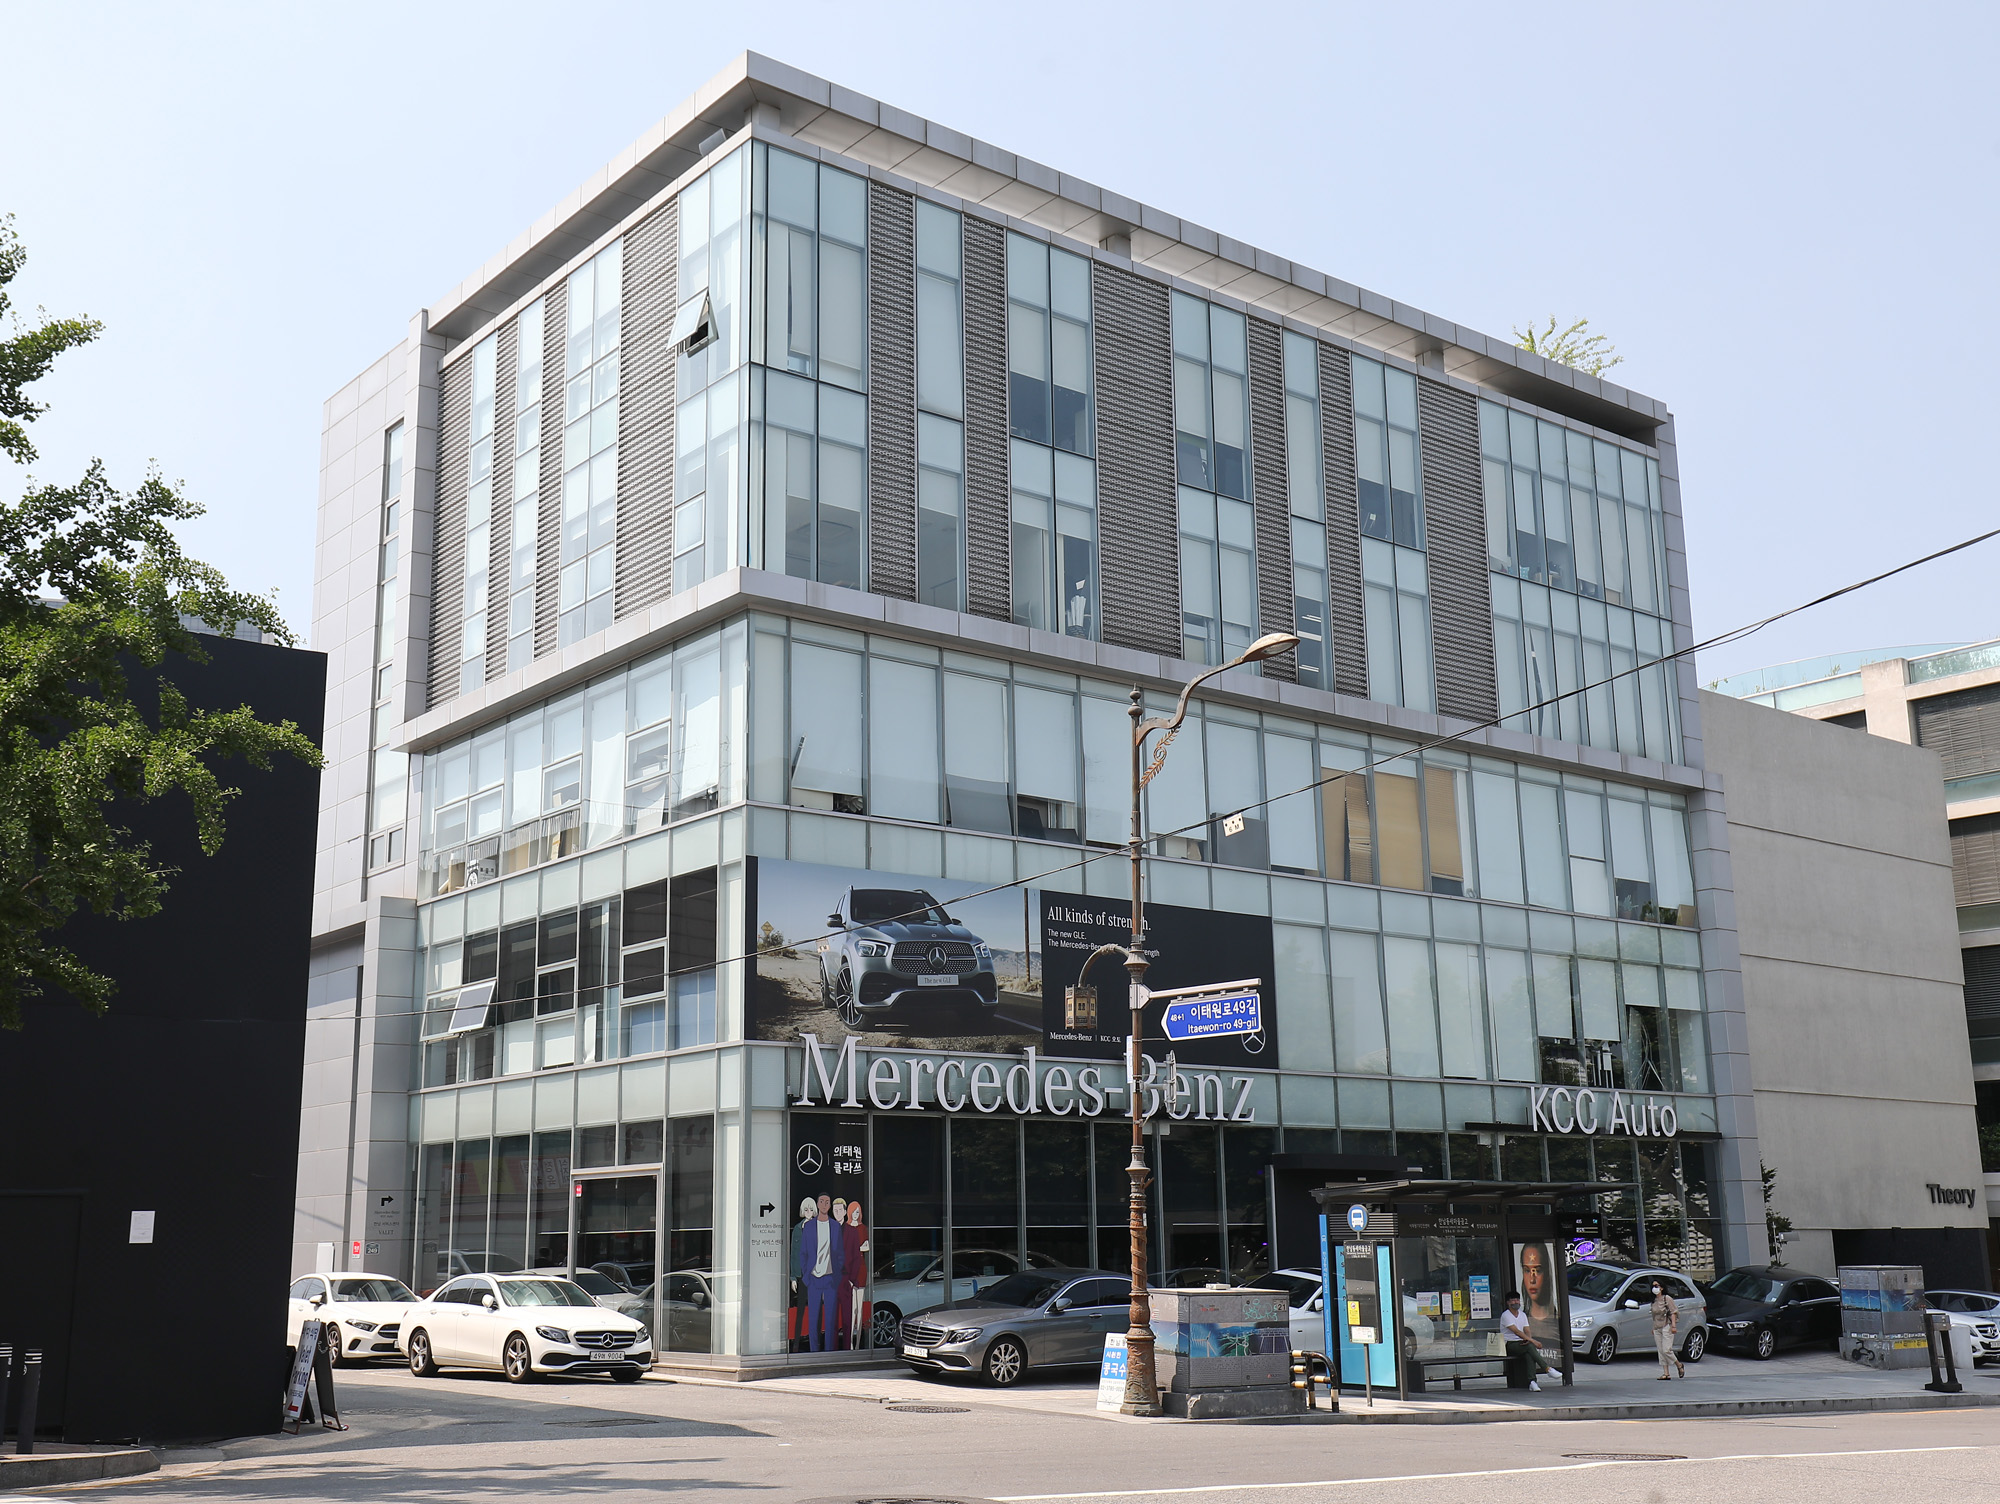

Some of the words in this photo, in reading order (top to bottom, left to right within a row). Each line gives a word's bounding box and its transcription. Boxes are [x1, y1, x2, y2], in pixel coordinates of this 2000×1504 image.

[1047, 905, 1062, 921] All
[1065, 907, 1093, 925] kinds
[1096, 911, 1107, 926] of
[1108, 914, 1151, 931] strenh.
[1048, 928, 1059, 938] The
[1060, 931, 1072, 939] new
[1073, 931, 1087, 940] GLE.
[1048, 938, 1059, 948] The
[1060, 940, 1101, 951] Mercedes-Ben
[1190, 998, 1257, 1020] 이태원로49길
[1188, 1021, 1232, 1034] Itaewon-ro
[1233, 1017, 1257, 1030] 49-gil
[1050, 1032, 1092, 1041] Mercedes-Benz
[792, 1033, 1256, 1122] Mercedes-Benz
[1530, 1086, 1598, 1135] KCC
[1609, 1091, 1677, 1137] Auto
[834, 1145, 862, 1158] 이태원
[834, 1161, 864, 1175] 클라쓰
[1926, 1183, 1976, 1209] Theory
[1277, 1303, 1287, 1311] 21
[1106, 1351, 1122, 1359] 시원한
[1103, 1362, 1126, 1377] 콩국수
